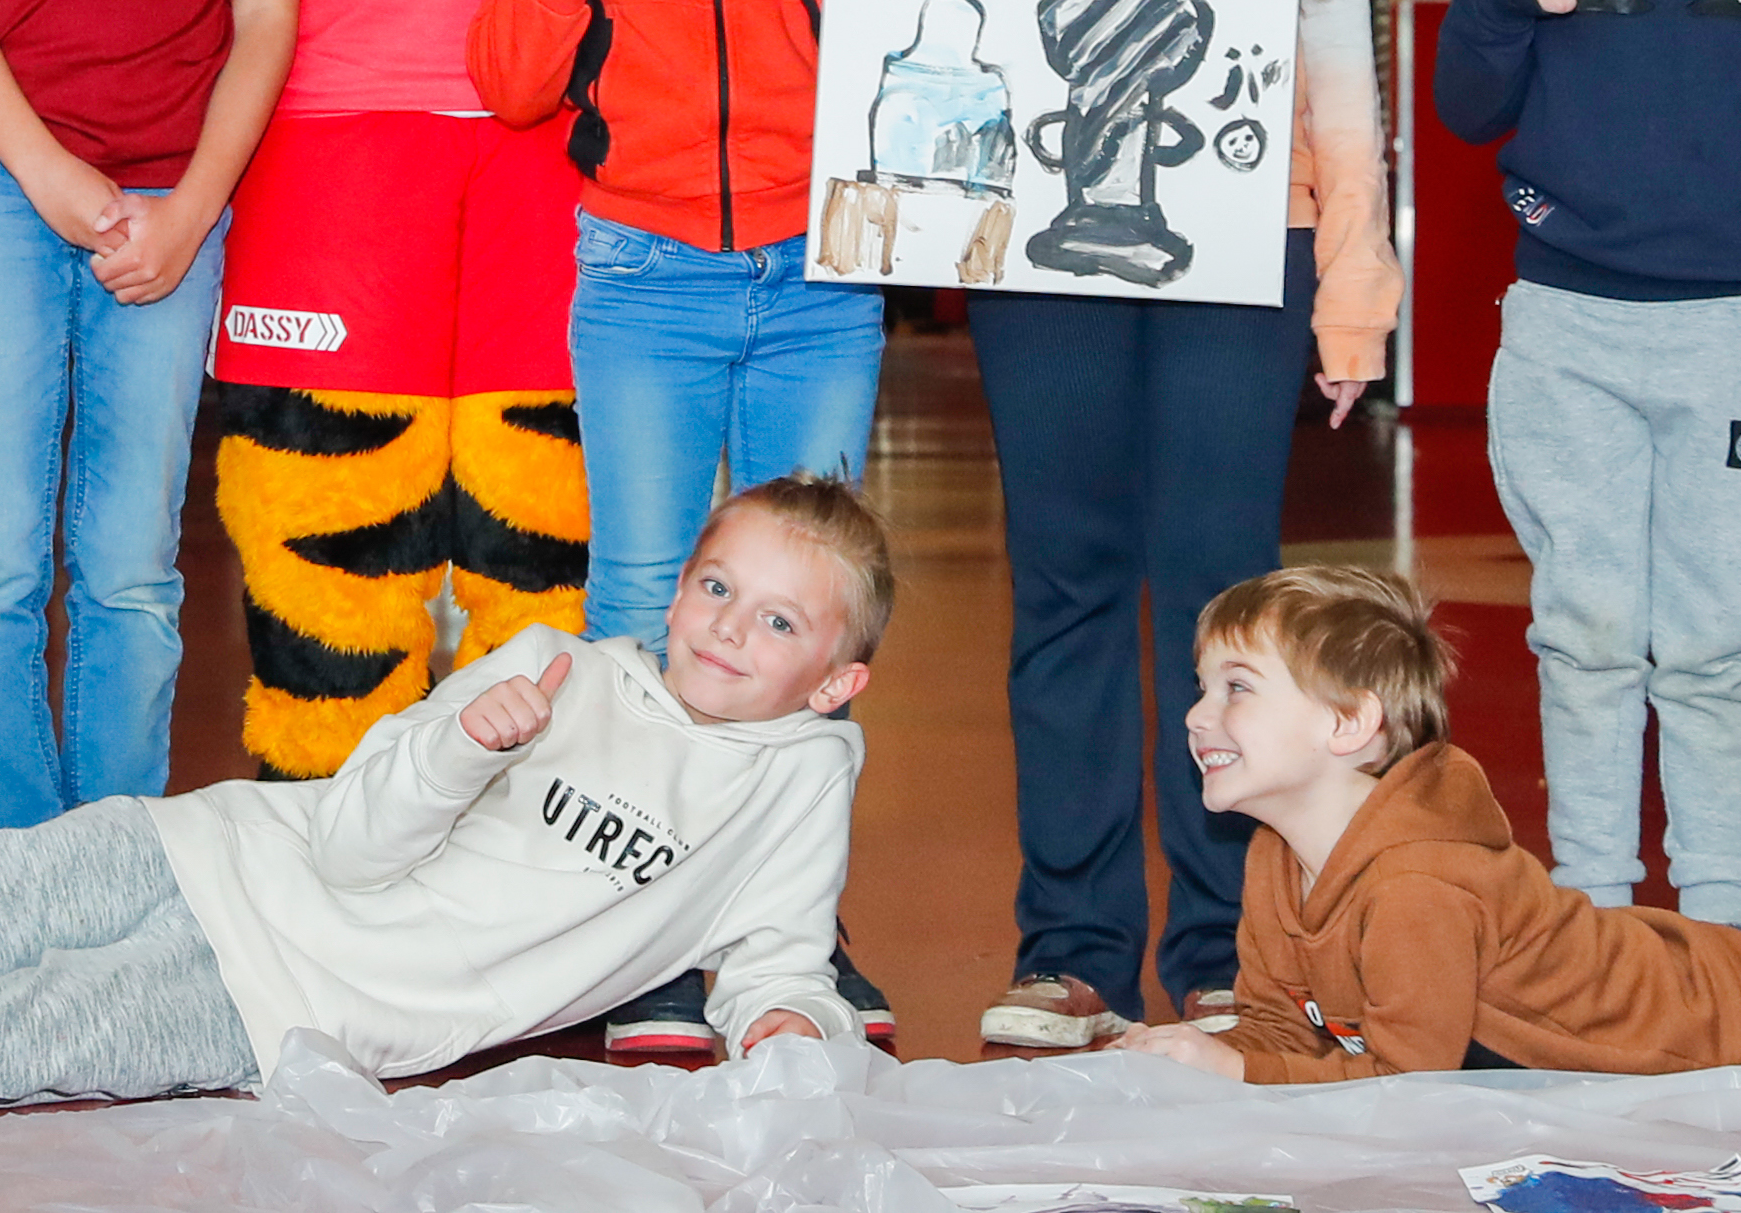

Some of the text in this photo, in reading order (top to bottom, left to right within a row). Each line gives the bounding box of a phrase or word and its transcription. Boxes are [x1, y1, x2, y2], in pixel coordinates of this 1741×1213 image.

[233, 311, 314, 344] DASSY
[608, 793, 690, 851] FOOTBALL CLUB
